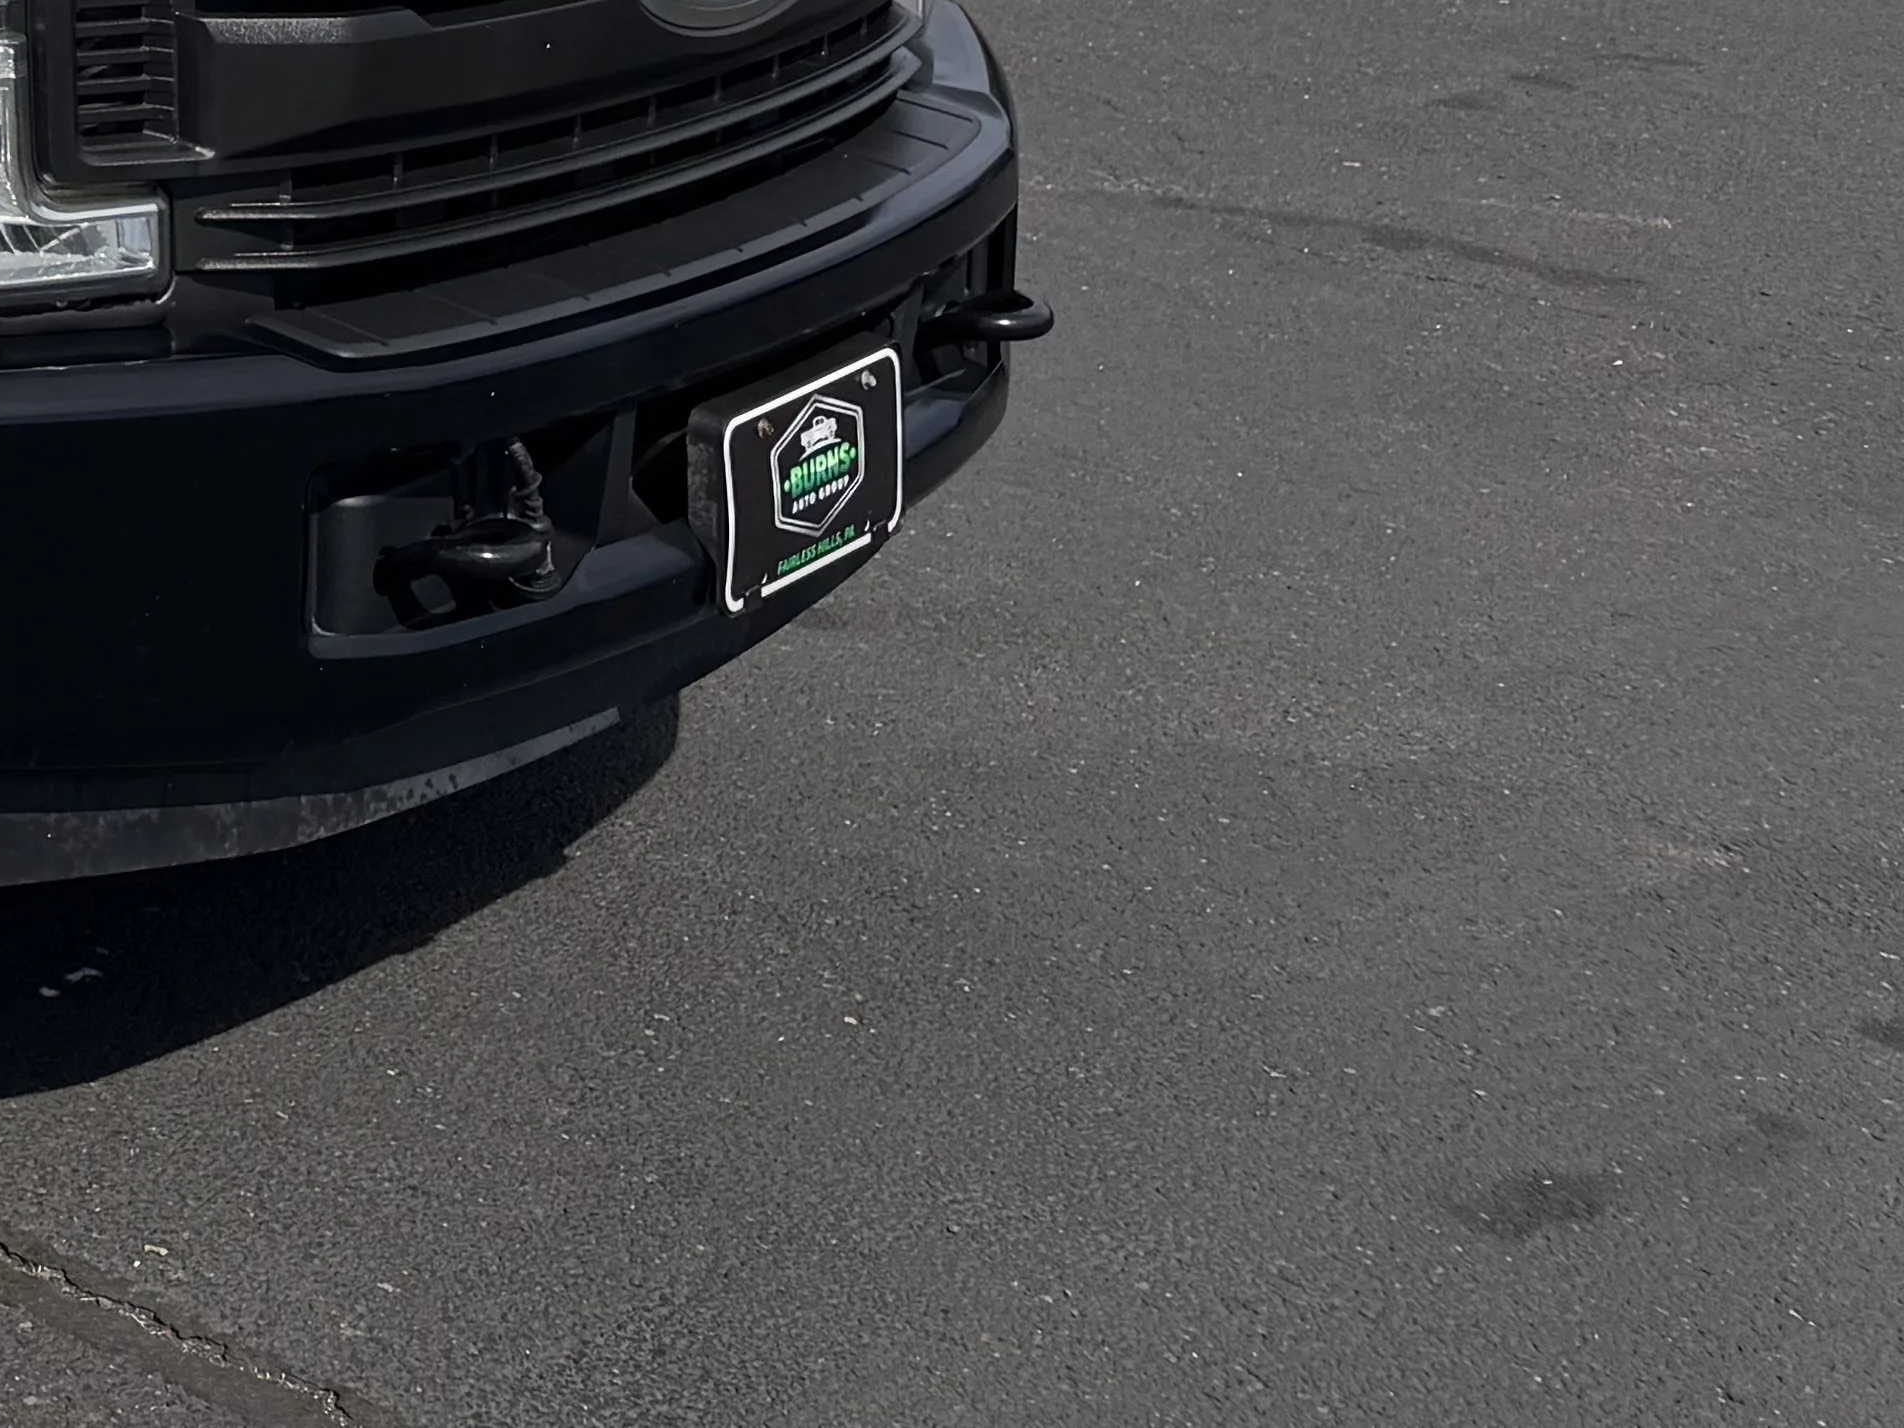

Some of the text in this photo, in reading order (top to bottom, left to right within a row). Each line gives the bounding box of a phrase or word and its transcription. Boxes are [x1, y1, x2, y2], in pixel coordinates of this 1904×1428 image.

[790, 442, 851, 498] BURNS
[792, 475, 849, 514] AUTO GROUP
